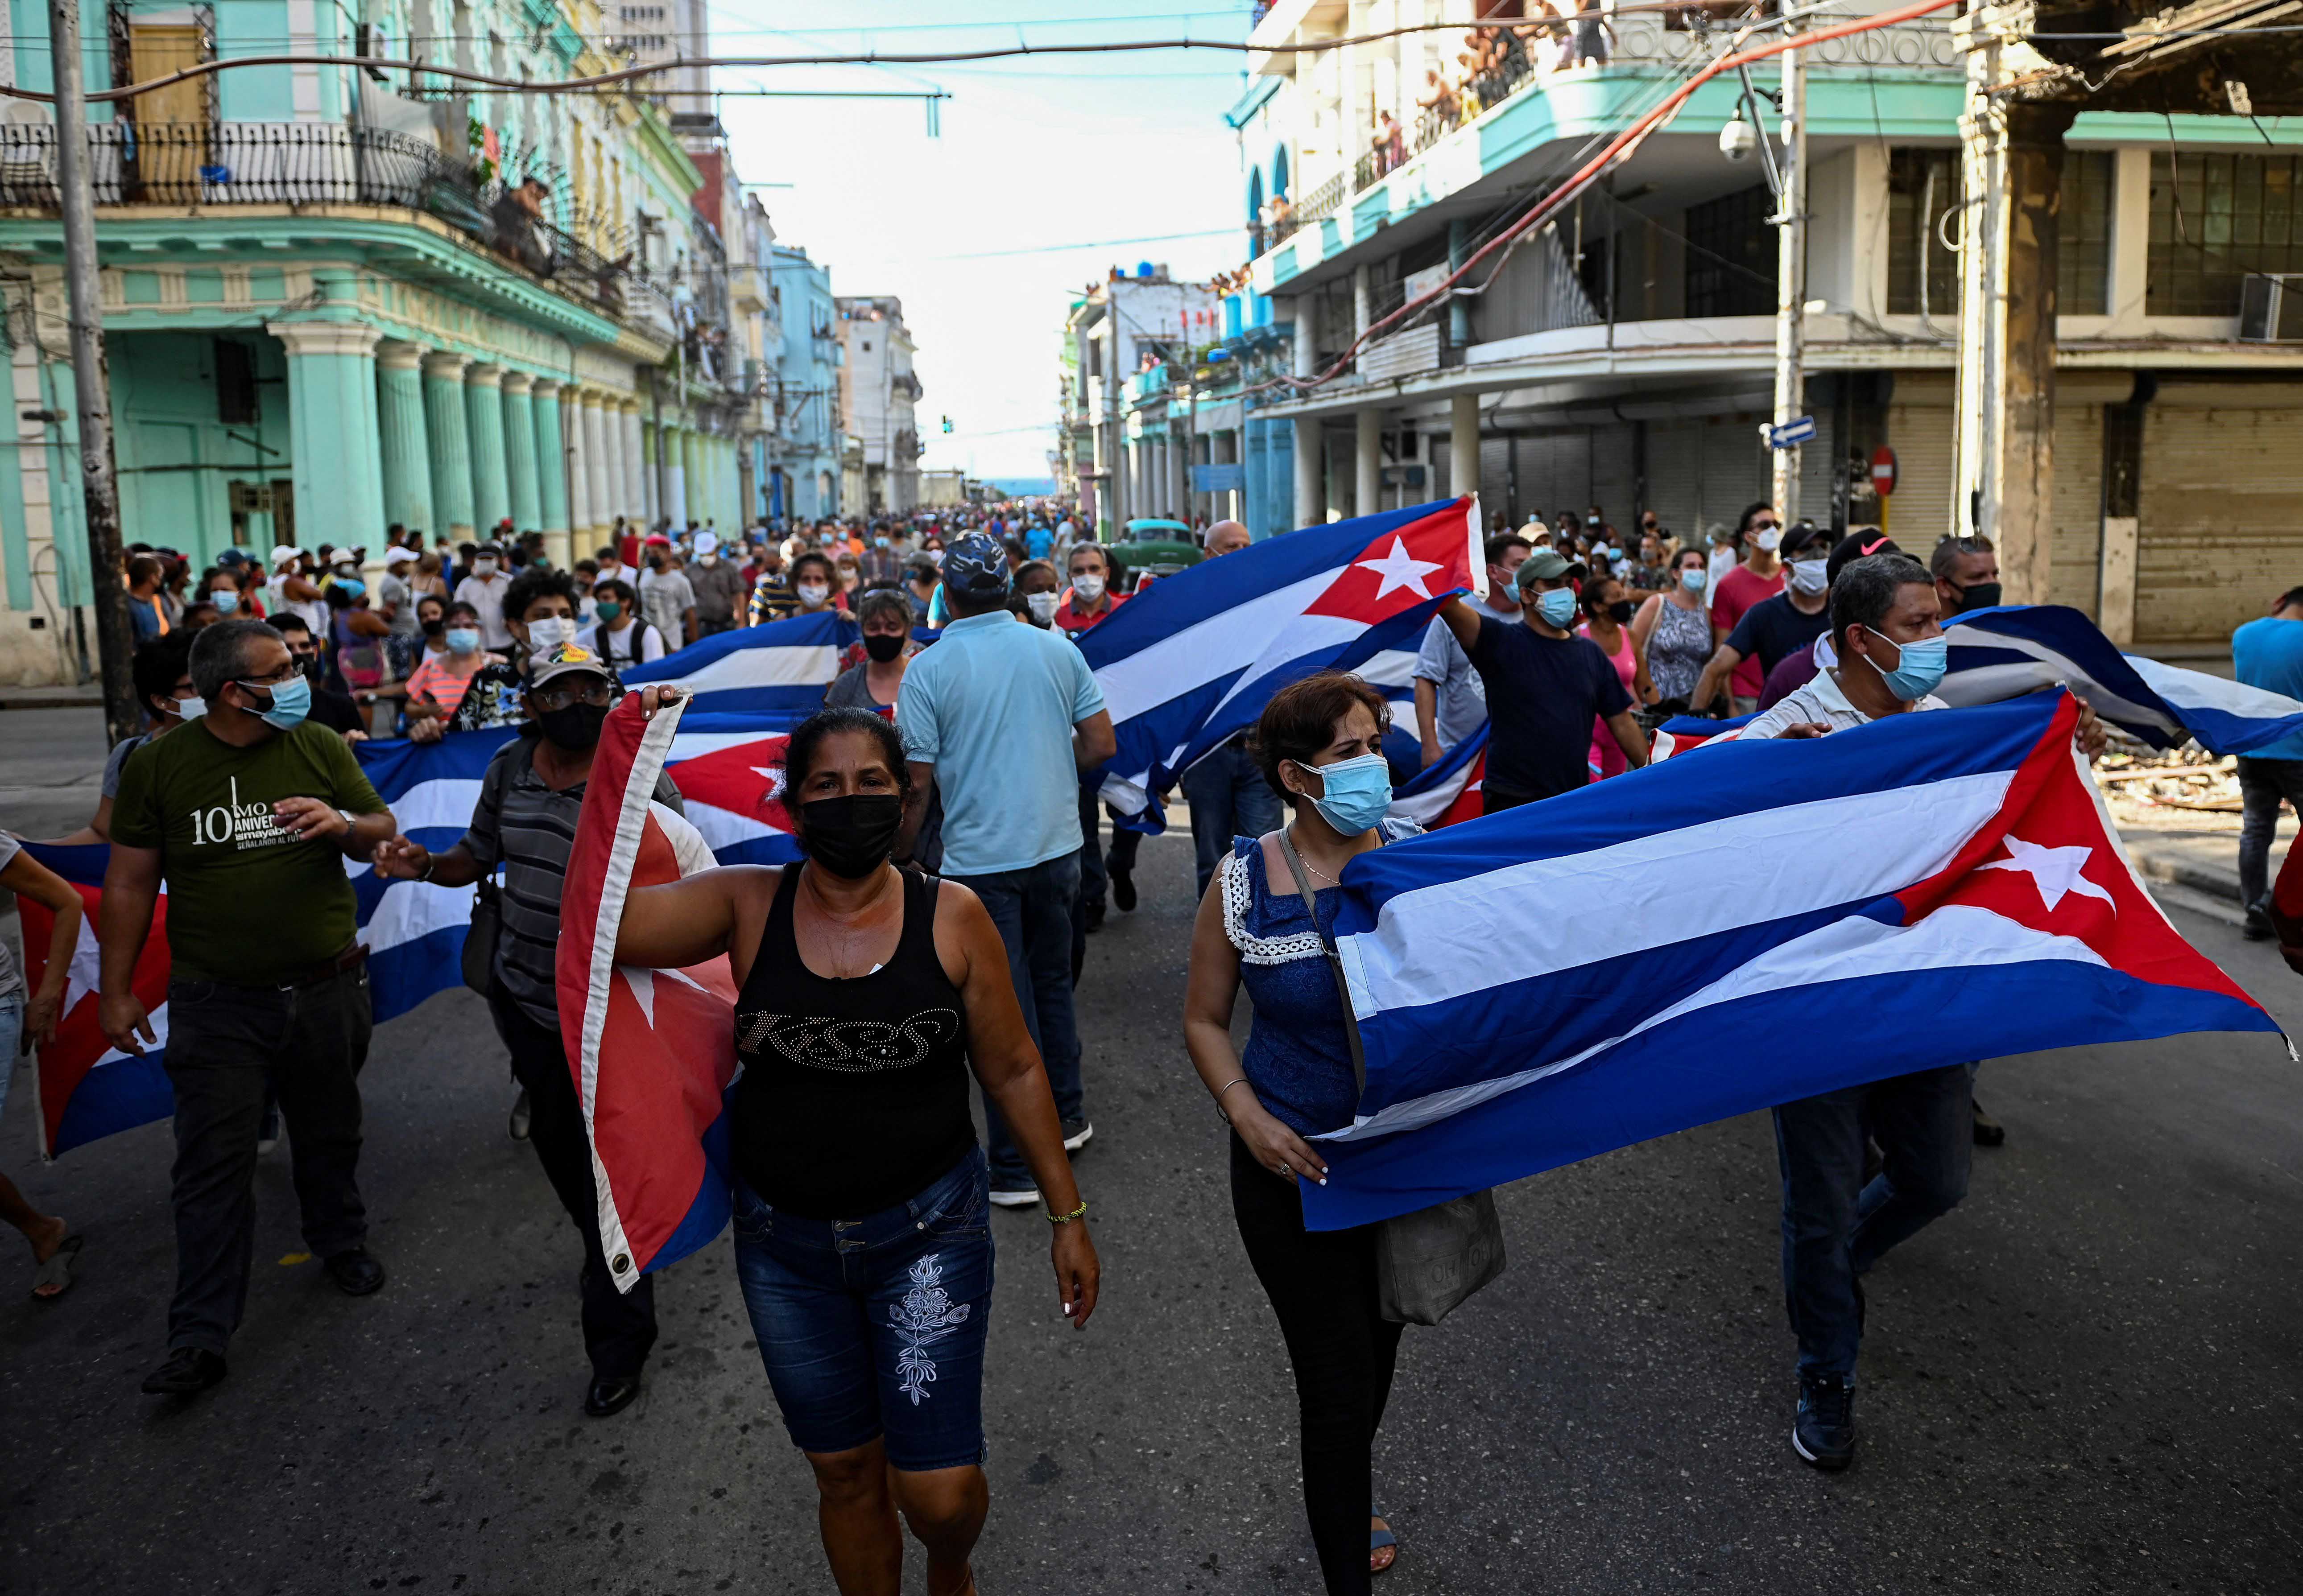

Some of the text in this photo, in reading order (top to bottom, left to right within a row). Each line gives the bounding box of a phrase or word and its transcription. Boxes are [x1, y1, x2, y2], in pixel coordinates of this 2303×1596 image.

[190, 807, 232, 845] 10
[235, 813, 298, 832] ANIVER
[287, 834, 300, 843] FUT
